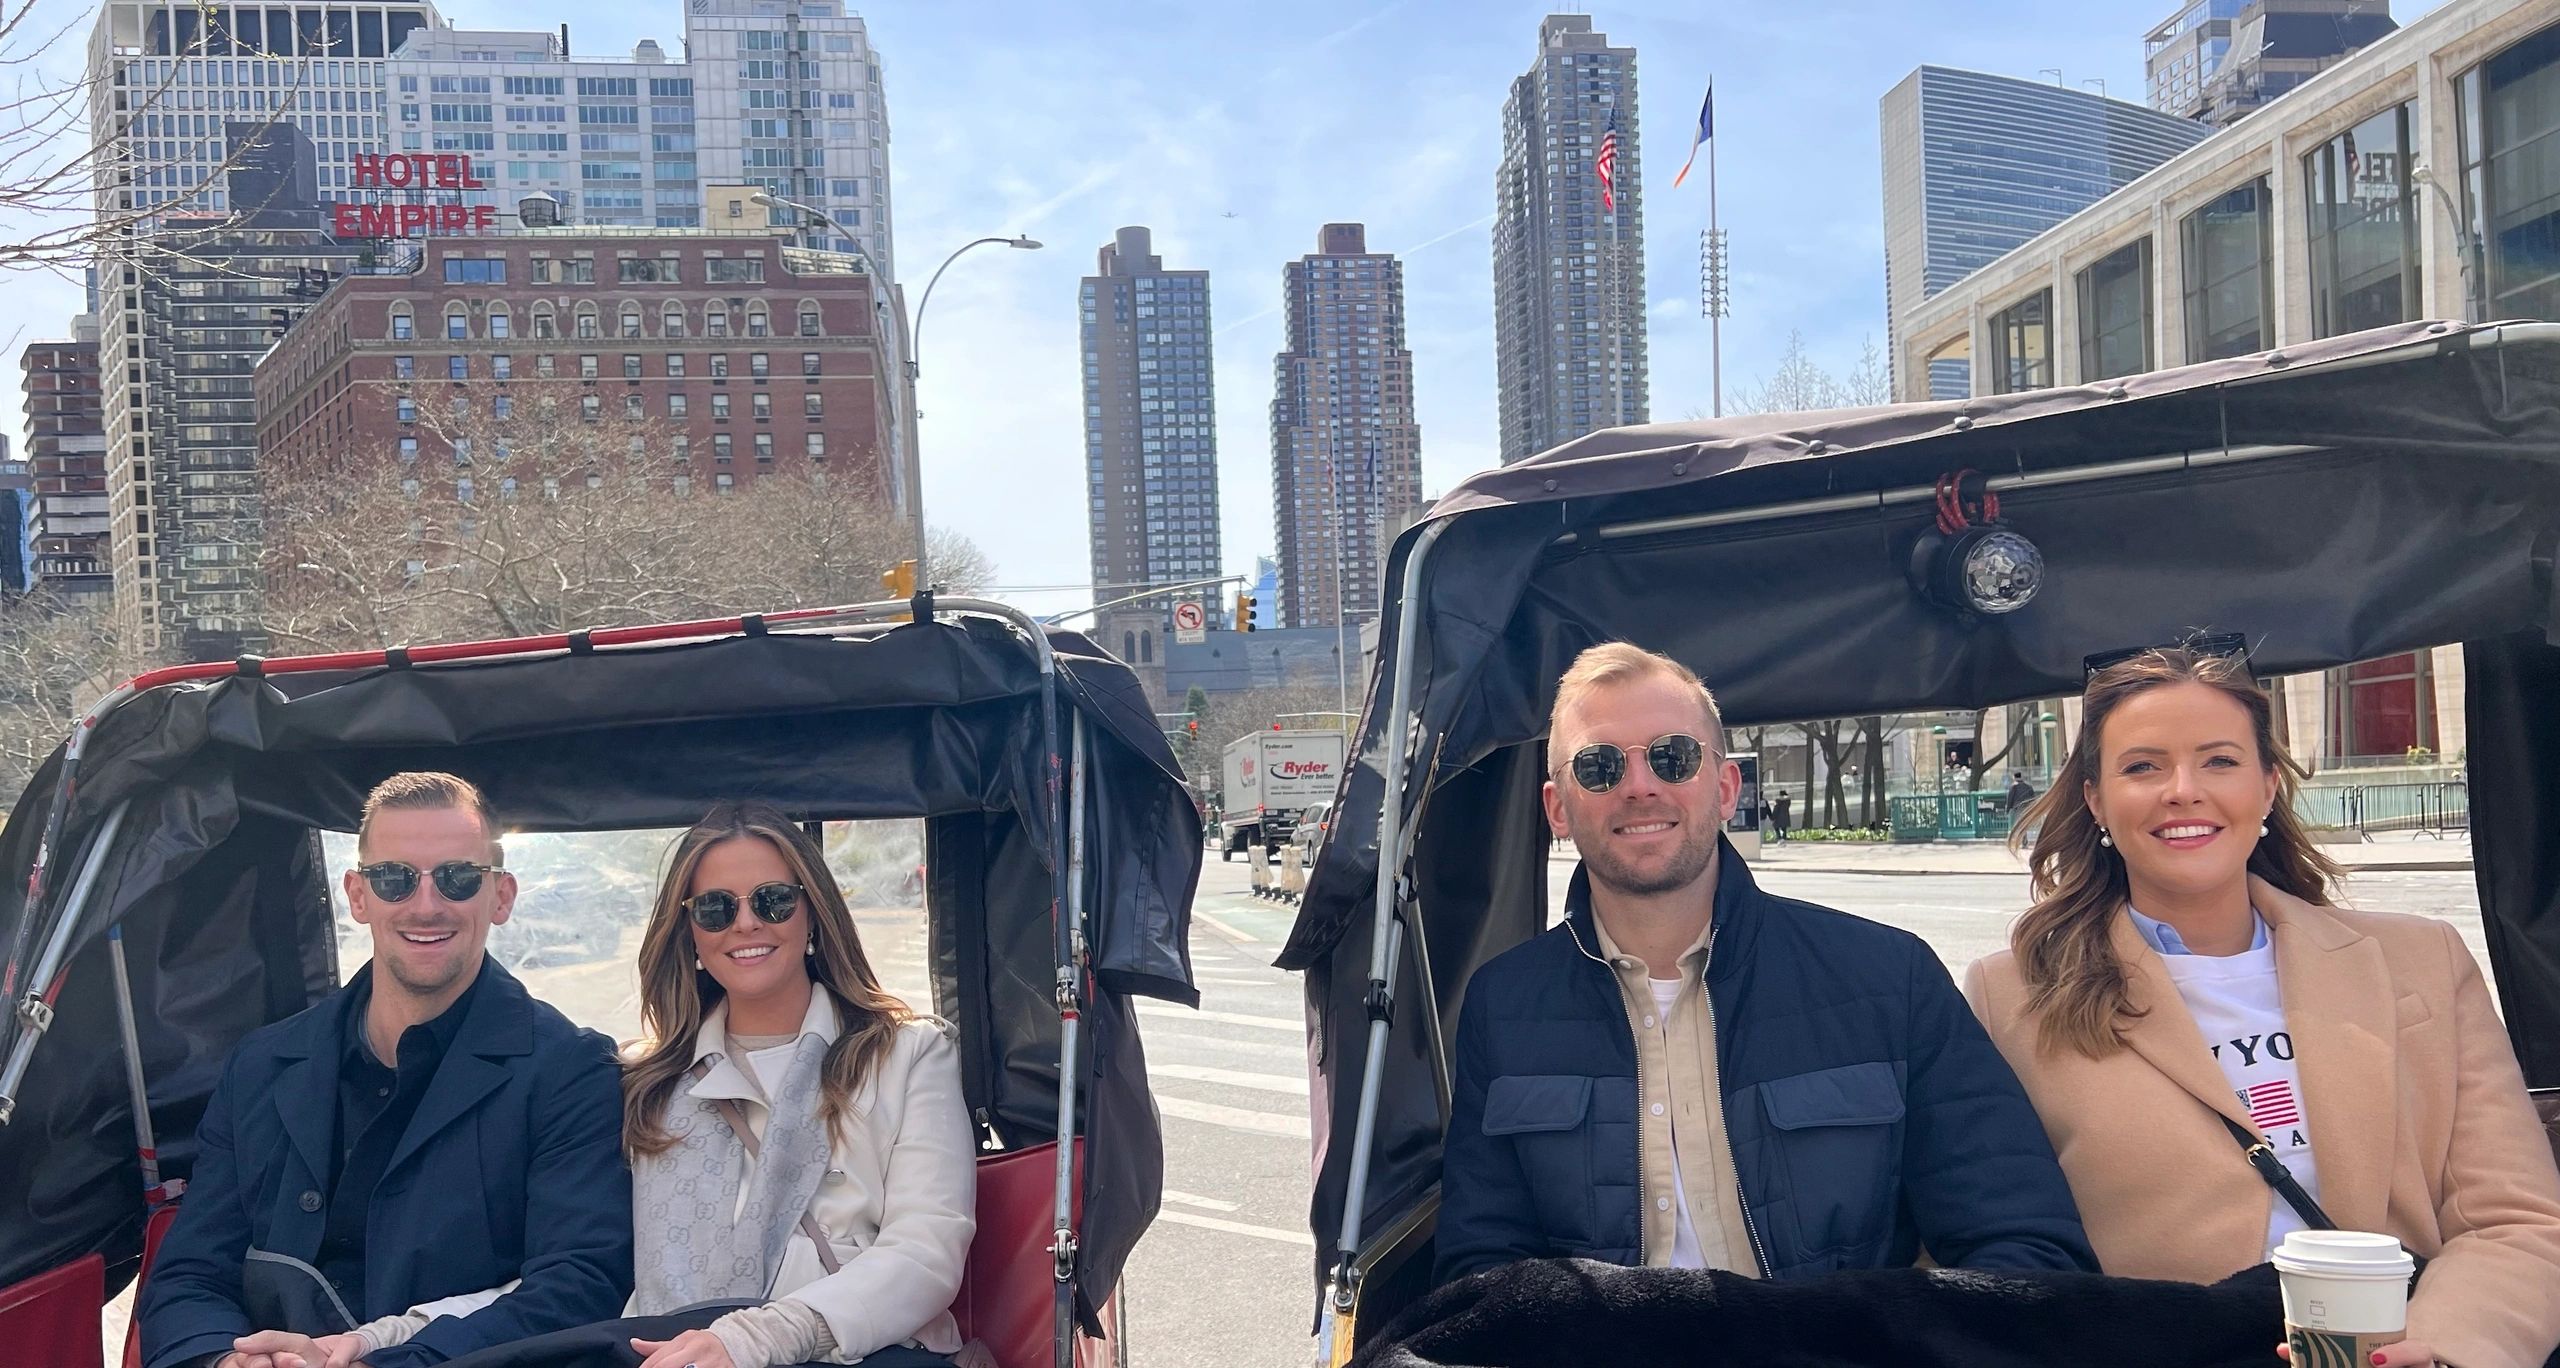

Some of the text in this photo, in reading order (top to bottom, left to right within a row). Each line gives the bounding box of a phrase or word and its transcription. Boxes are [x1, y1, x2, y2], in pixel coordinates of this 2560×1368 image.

[355, 153, 482, 187] HOTEL
[335, 203, 495, 238] EMPIRE
[1284, 761, 1329, 776] Ryder
